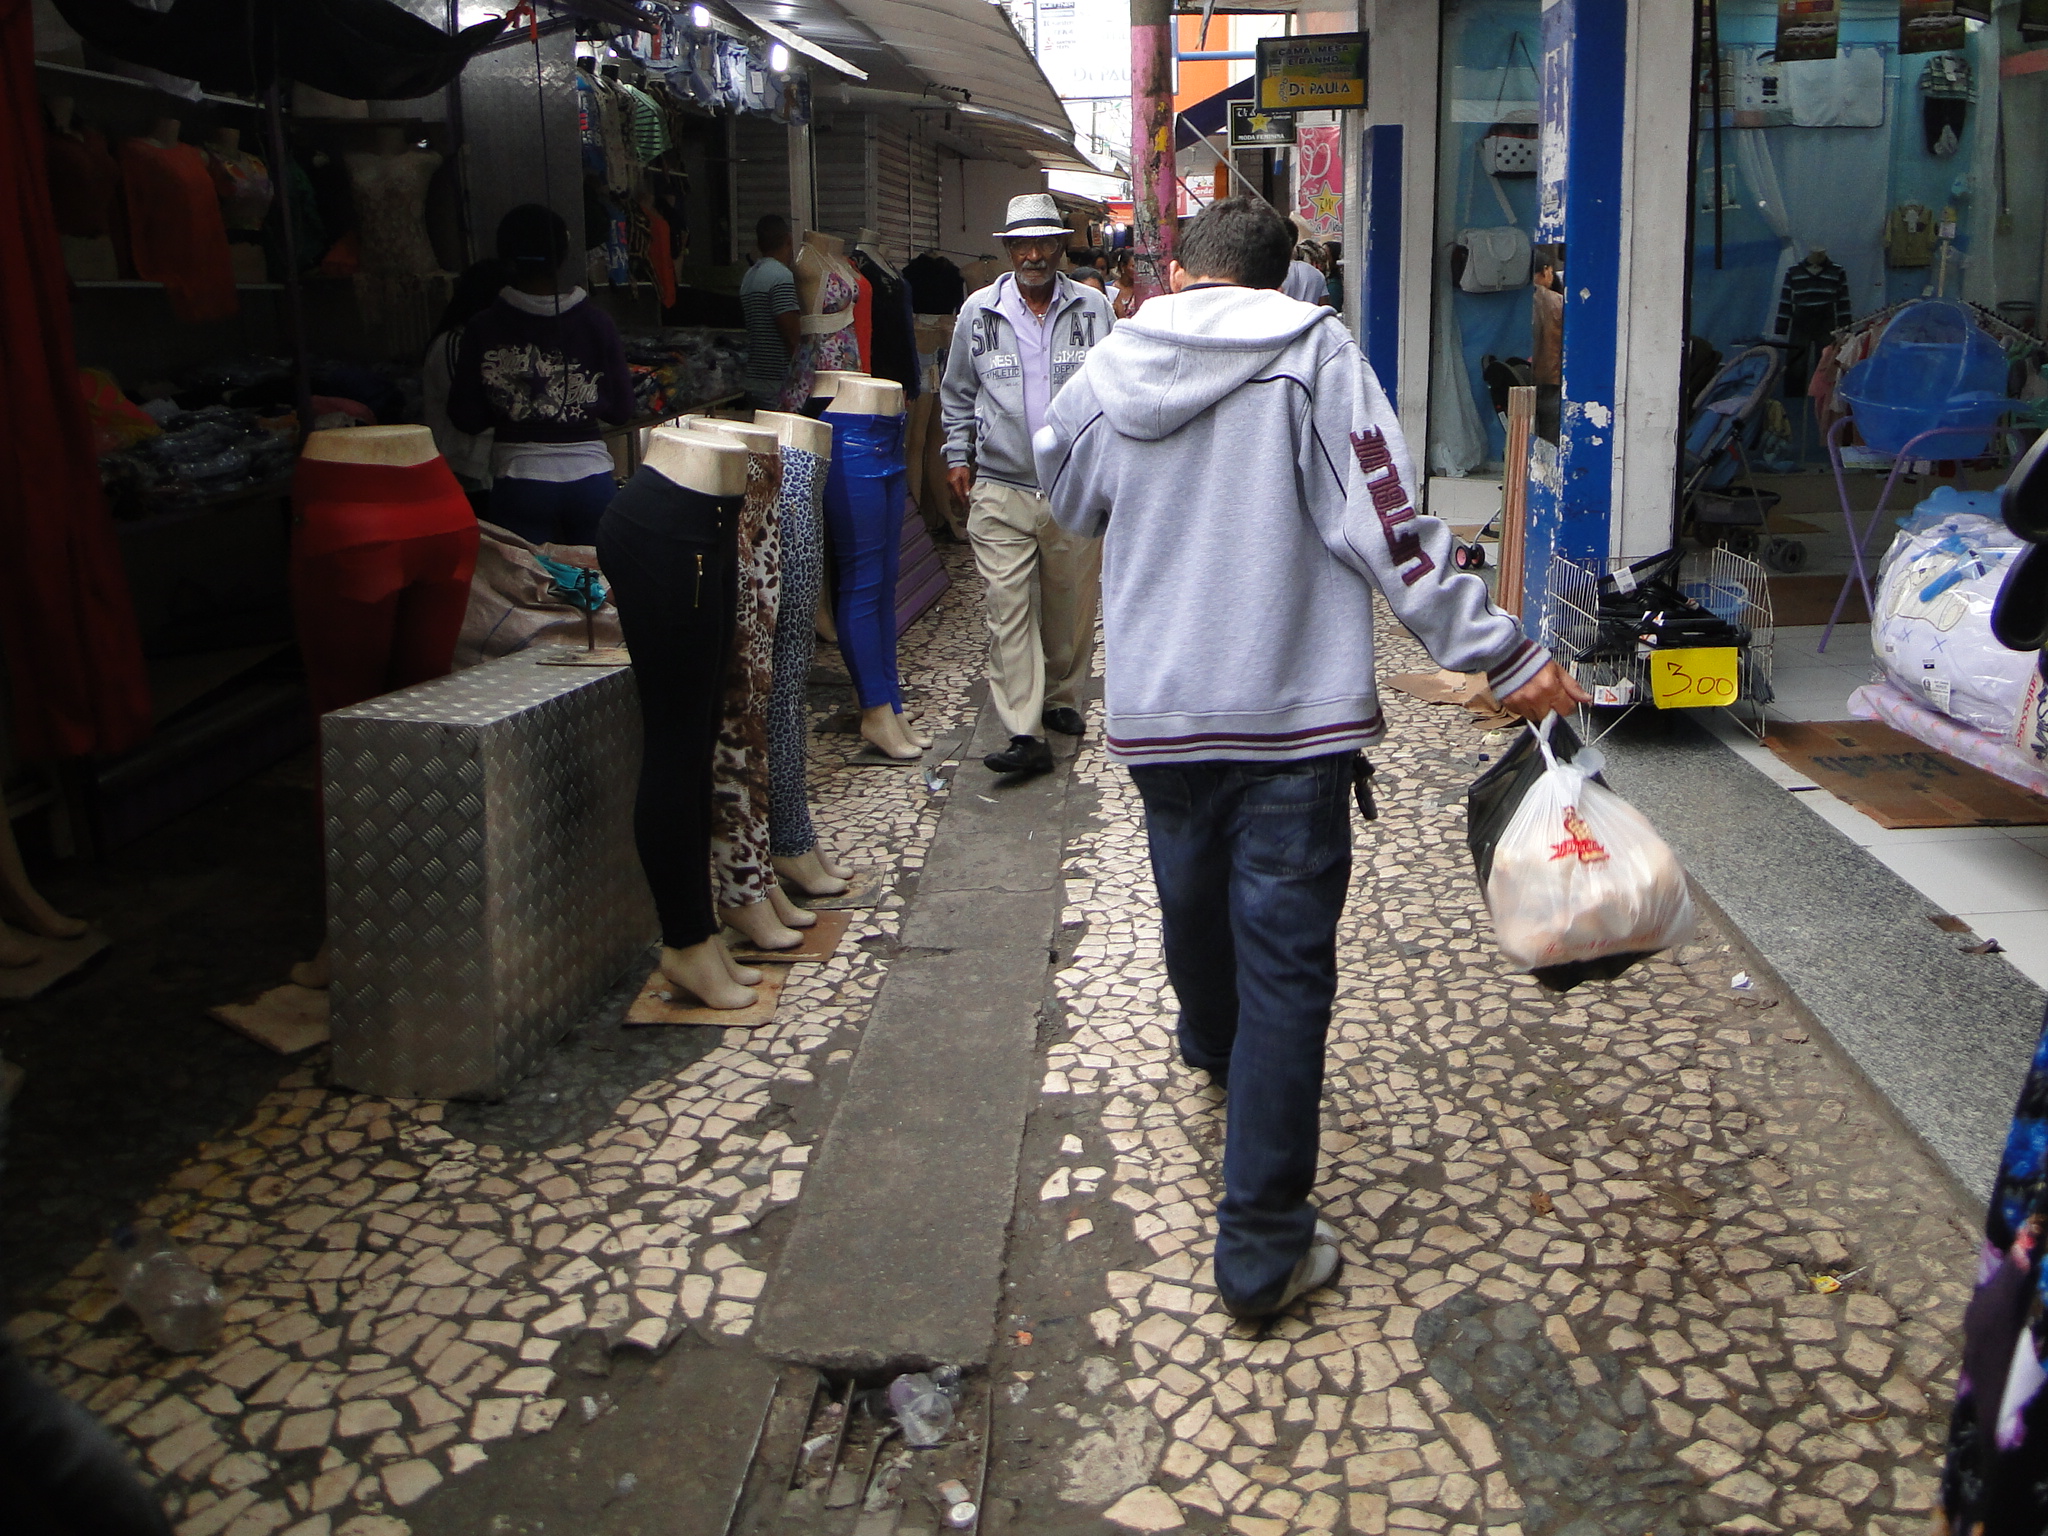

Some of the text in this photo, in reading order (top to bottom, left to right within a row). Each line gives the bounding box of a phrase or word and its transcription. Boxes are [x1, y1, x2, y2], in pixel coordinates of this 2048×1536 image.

[1318, 45, 1349, 53] MESA
[1298, 55, 1339, 65] BANHO
[1289, 81, 1350, 96] Di PAULA
[971, 311, 1096, 357] SW AT
[1662, 661, 1734, 698] 3.00
